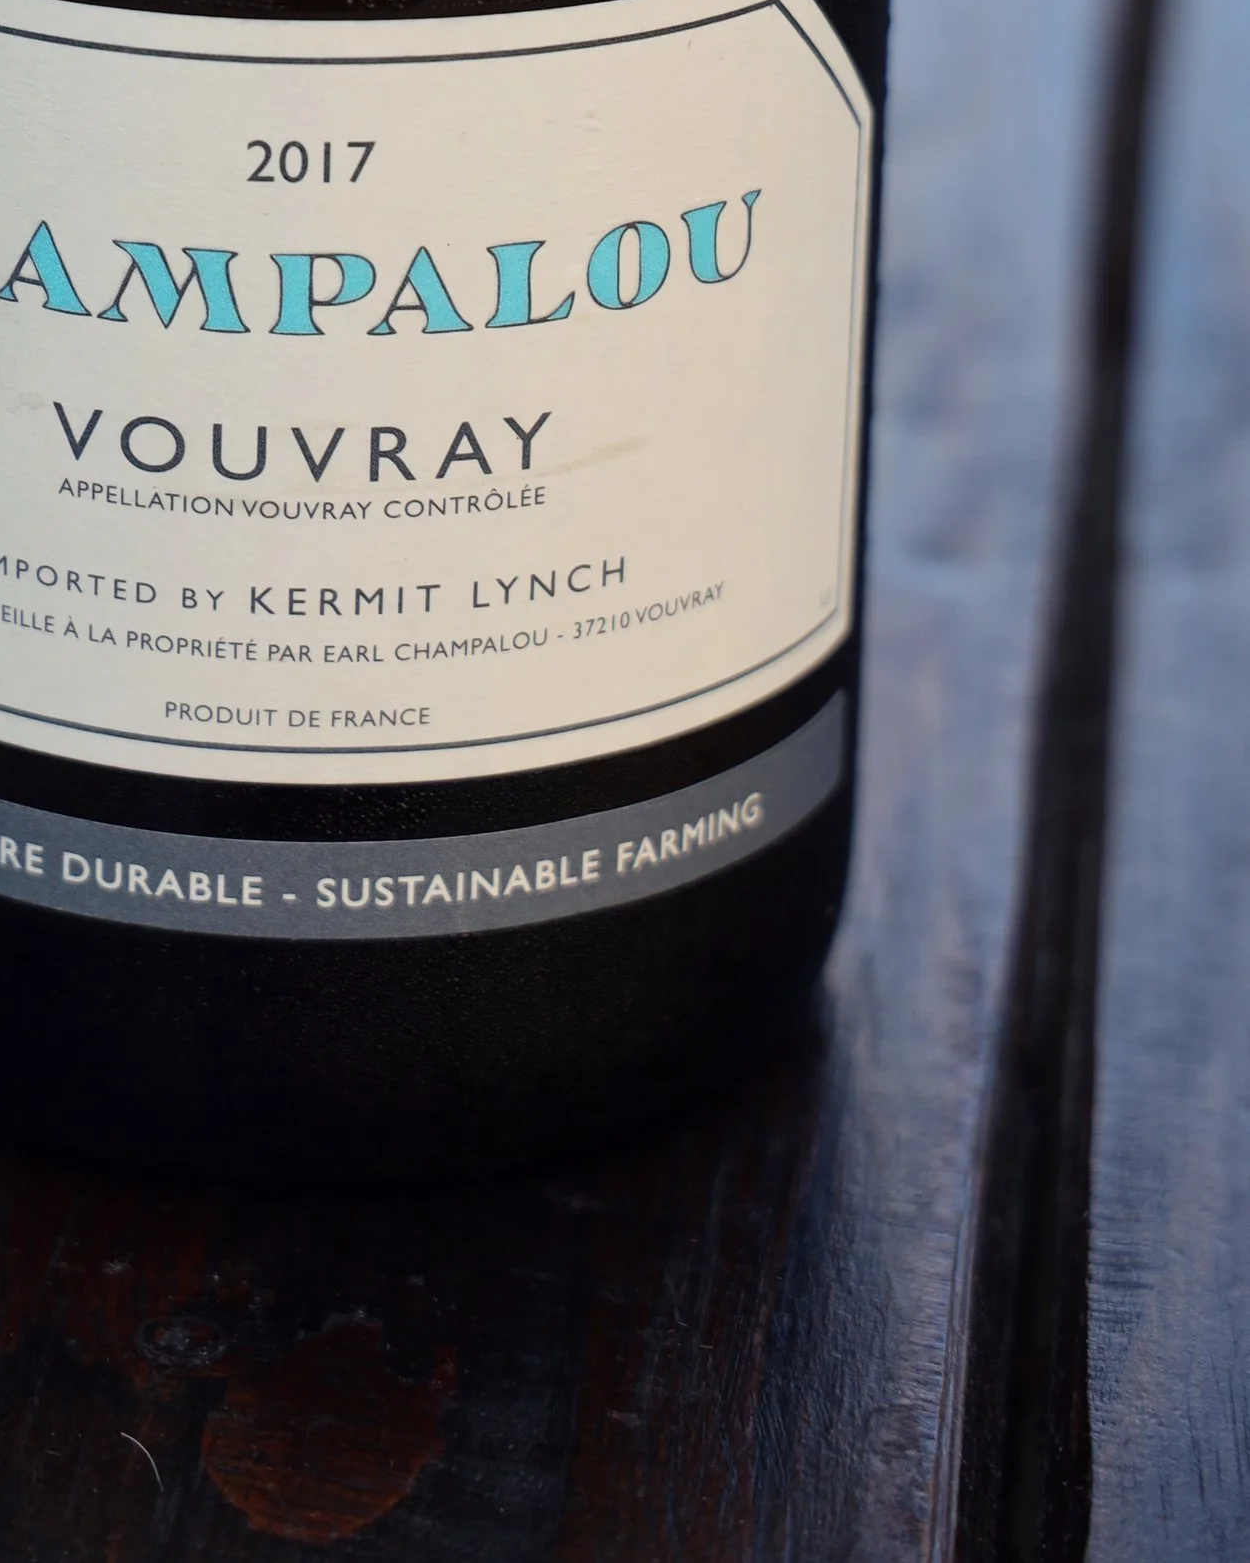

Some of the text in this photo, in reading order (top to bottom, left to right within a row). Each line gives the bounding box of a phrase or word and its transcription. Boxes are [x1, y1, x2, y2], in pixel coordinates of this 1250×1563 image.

[247, 140, 375, 183] 2017
[53, 401, 552, 482] VOUVRAY
[58, 478, 546, 520] APPELLATION VOUVRAY CONTRÔLÉE
[182, 588, 224, 612] BY
[251, 584, 441, 616] KERMIT
[472, 556, 626, 609] LYNCH
[64, 616, 78, 638] À
[88, 624, 116, 645] LA
[126, 630, 257, 661] PROPRIÉTÉ
[268, 644, 313, 662] PAR
[324, 644, 384, 663] EARL
[394, 627, 548, 661] CHAMPALOU
[573, 610, 630, 640] 37210
[634, 580, 725, 623] VOUVRAY
[165, 701, 430, 728] PRODUIT DE FRANCE
[62, 851, 263, 906] DURABLE
[316, 849, 600, 908] SUSTAINABLE
[617, 791, 765, 873] FARMING
